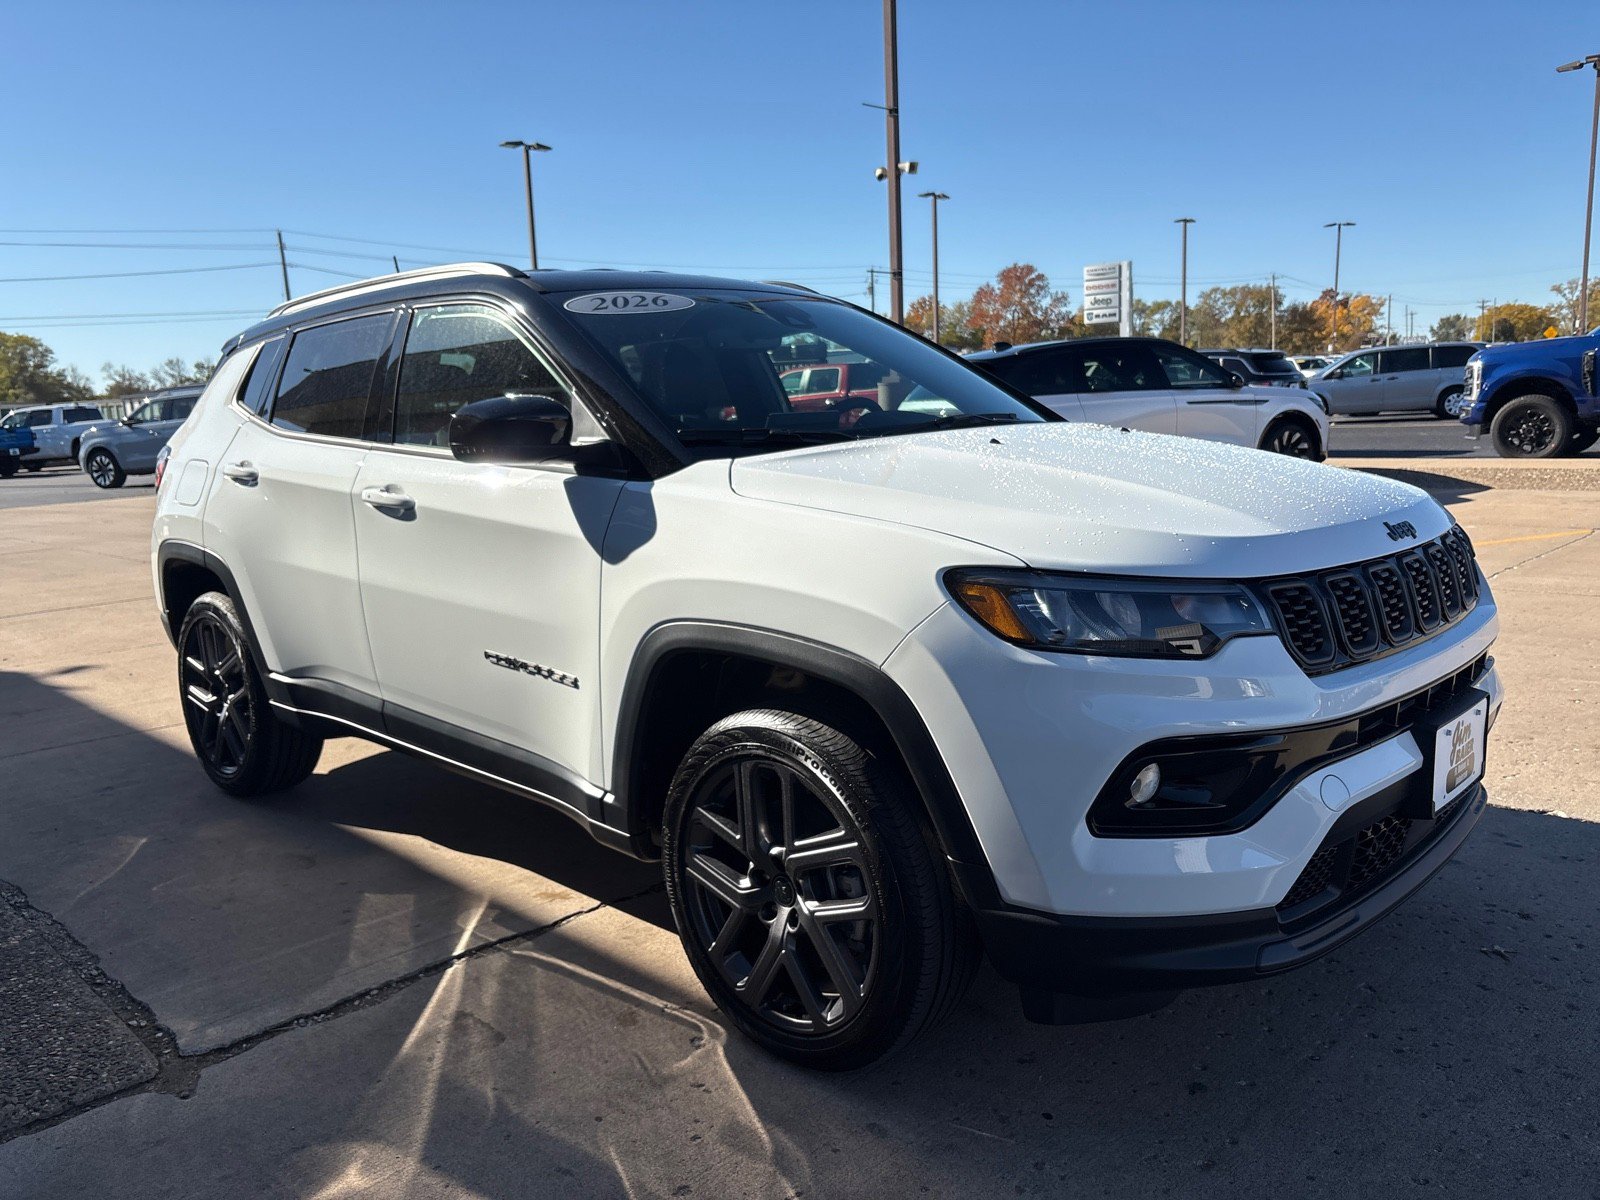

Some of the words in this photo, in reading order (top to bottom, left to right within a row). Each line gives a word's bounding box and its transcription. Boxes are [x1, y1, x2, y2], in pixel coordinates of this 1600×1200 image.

[590, 295, 669, 312] 2026
[1090, 296, 1113, 307] Jeep
[1382, 520, 1418, 541] Jeep
